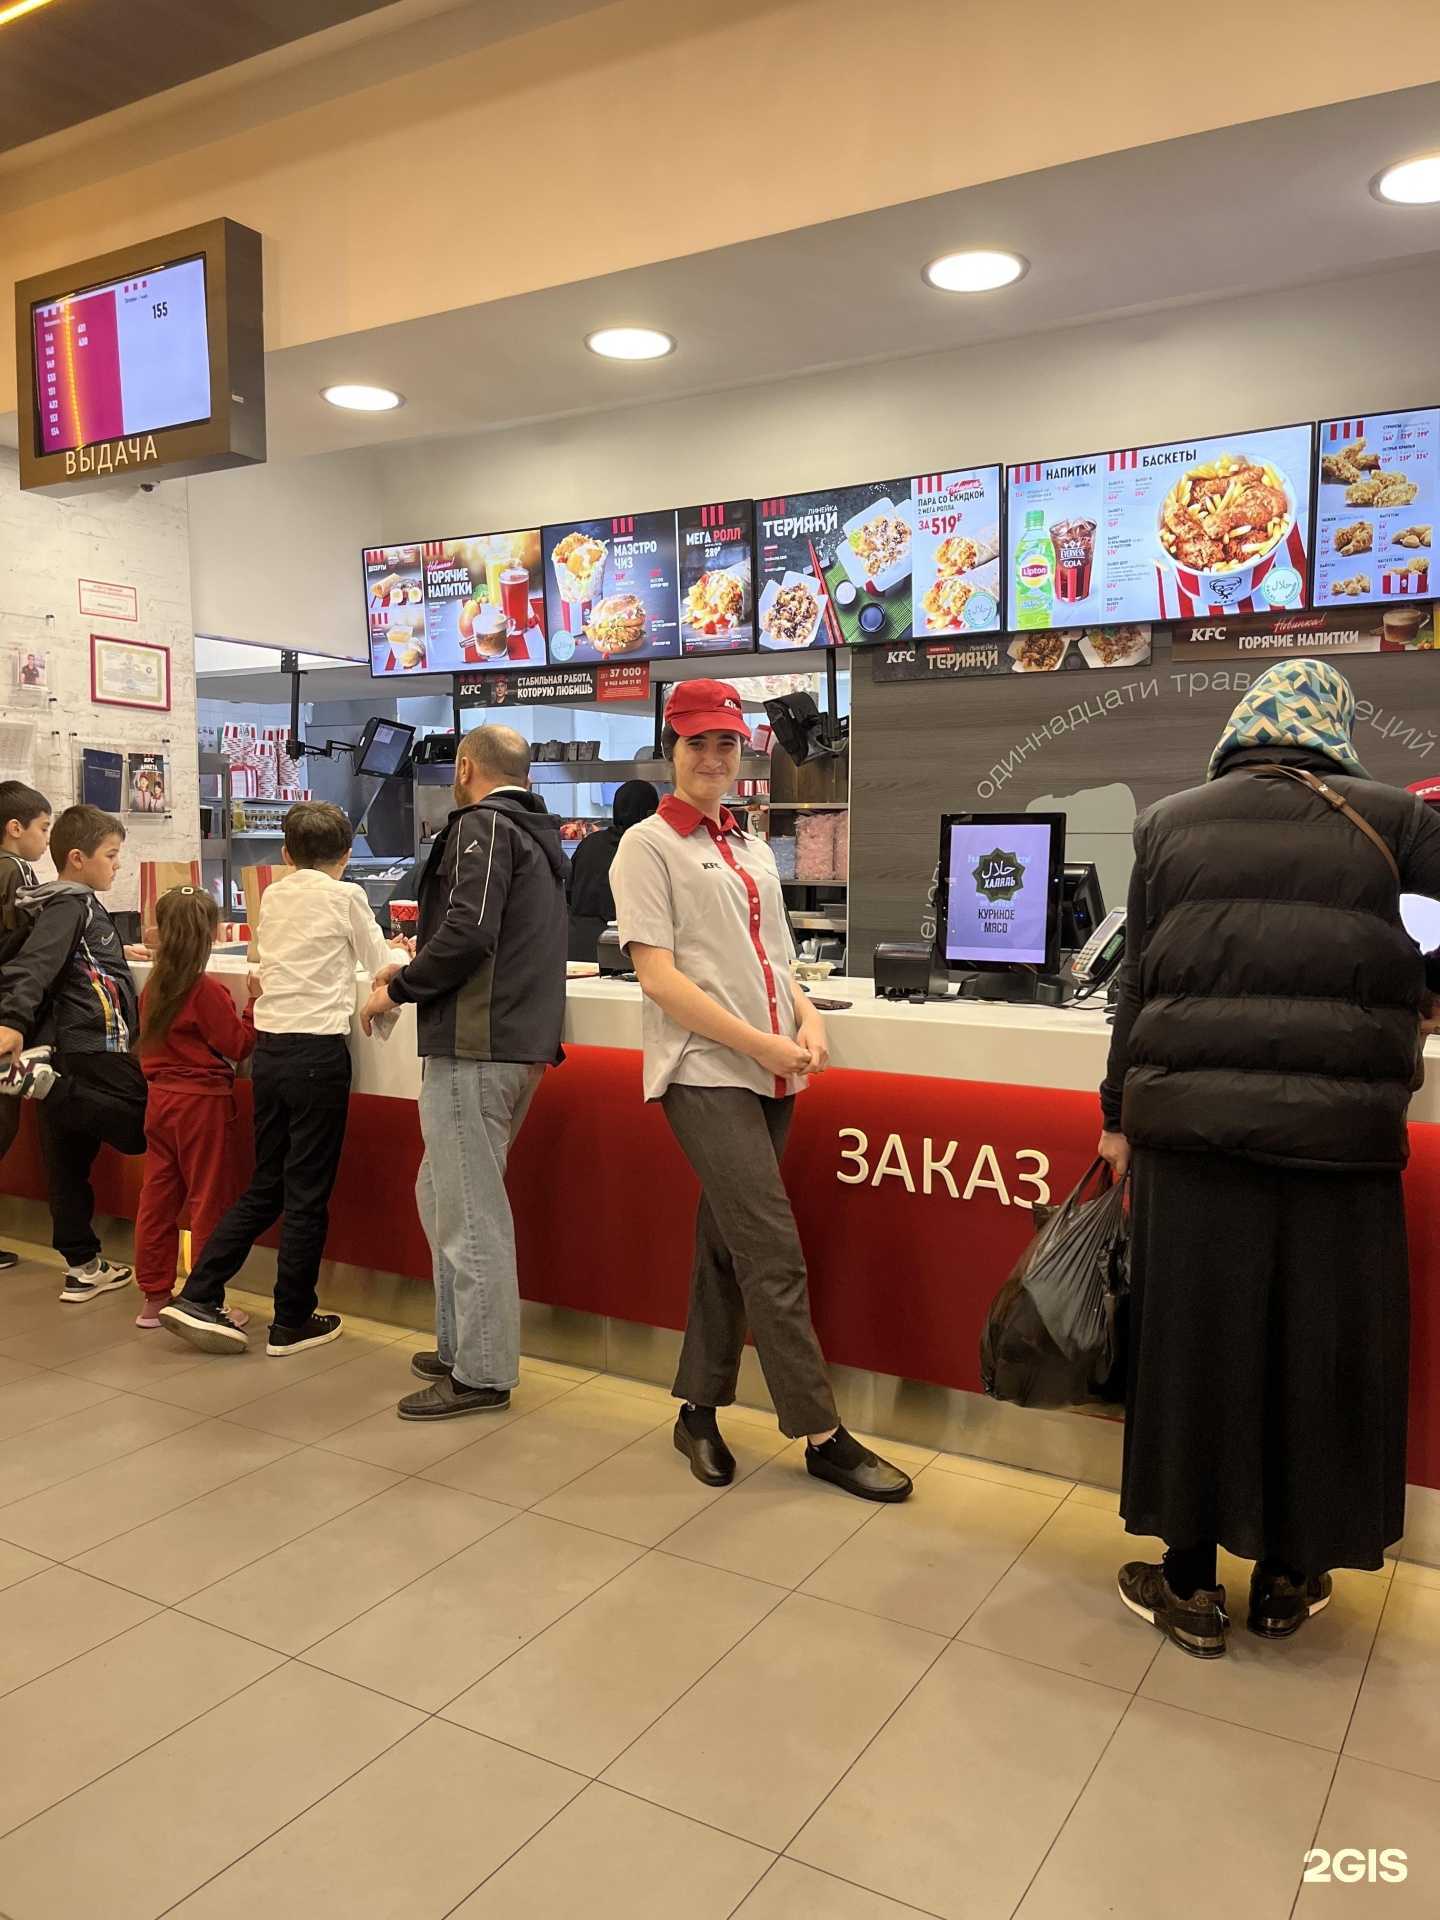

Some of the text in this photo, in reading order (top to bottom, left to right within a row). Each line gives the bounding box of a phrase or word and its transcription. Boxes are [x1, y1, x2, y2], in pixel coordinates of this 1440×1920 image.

[152, 302, 168, 319] 155
[65, 435, 159, 475] ВЫДАЧА
[1142, 449, 1197, 467] БАСКЕТЫ
[1046, 464, 1097, 480] НАПИТКИ
[918, 497, 937, 506] ПАРА
[938, 495, 948, 504] СО
[808, 504, 838, 515] ЛИНЕЙКА
[762, 511, 838, 539] ТЕРИЯКИ
[918, 520, 930, 530] ЗА
[686, 527, 742, 546] МЕГА РОЛЛ
[613, 541, 657, 557] МАЭСТРО
[614, 557, 634, 570] ЧИЗ
[1063, 560, 1082, 568] COLA
[427, 567, 469, 585] ГОРЯЧИЕ
[1022, 567, 1047, 577] Lipton
[428, 581, 473, 598] НАПИТКИ
[1189, 627, 1227, 642] KFC
[1238, 630, 1360, 650] ГОРЯЧИЕ НАПИТКИ
[886, 651, 916, 664] KFC
[926, 650, 999, 672] ТЕРИЯКИ
[517, 672, 593, 687] СТАБИЛЬНАЯ РАБОТА,
[609, 667, 641, 678] 37 000
[460, 684, 482, 696] KFC
[517, 686, 555, 699] КОТОРУЮ
[555, 684, 593, 697] ЛЮБИШЬ
[976, 678, 1160, 800] одиннадцати
[1171, 671, 1251, 697] трав
[981, 860, 1016, 879] حلال
[978, 908, 1016, 920] КУРИНОЕ
[983, 922, 1008, 934] МЯСО
[837, 1128, 1051, 1209] ЗАКАЗ
